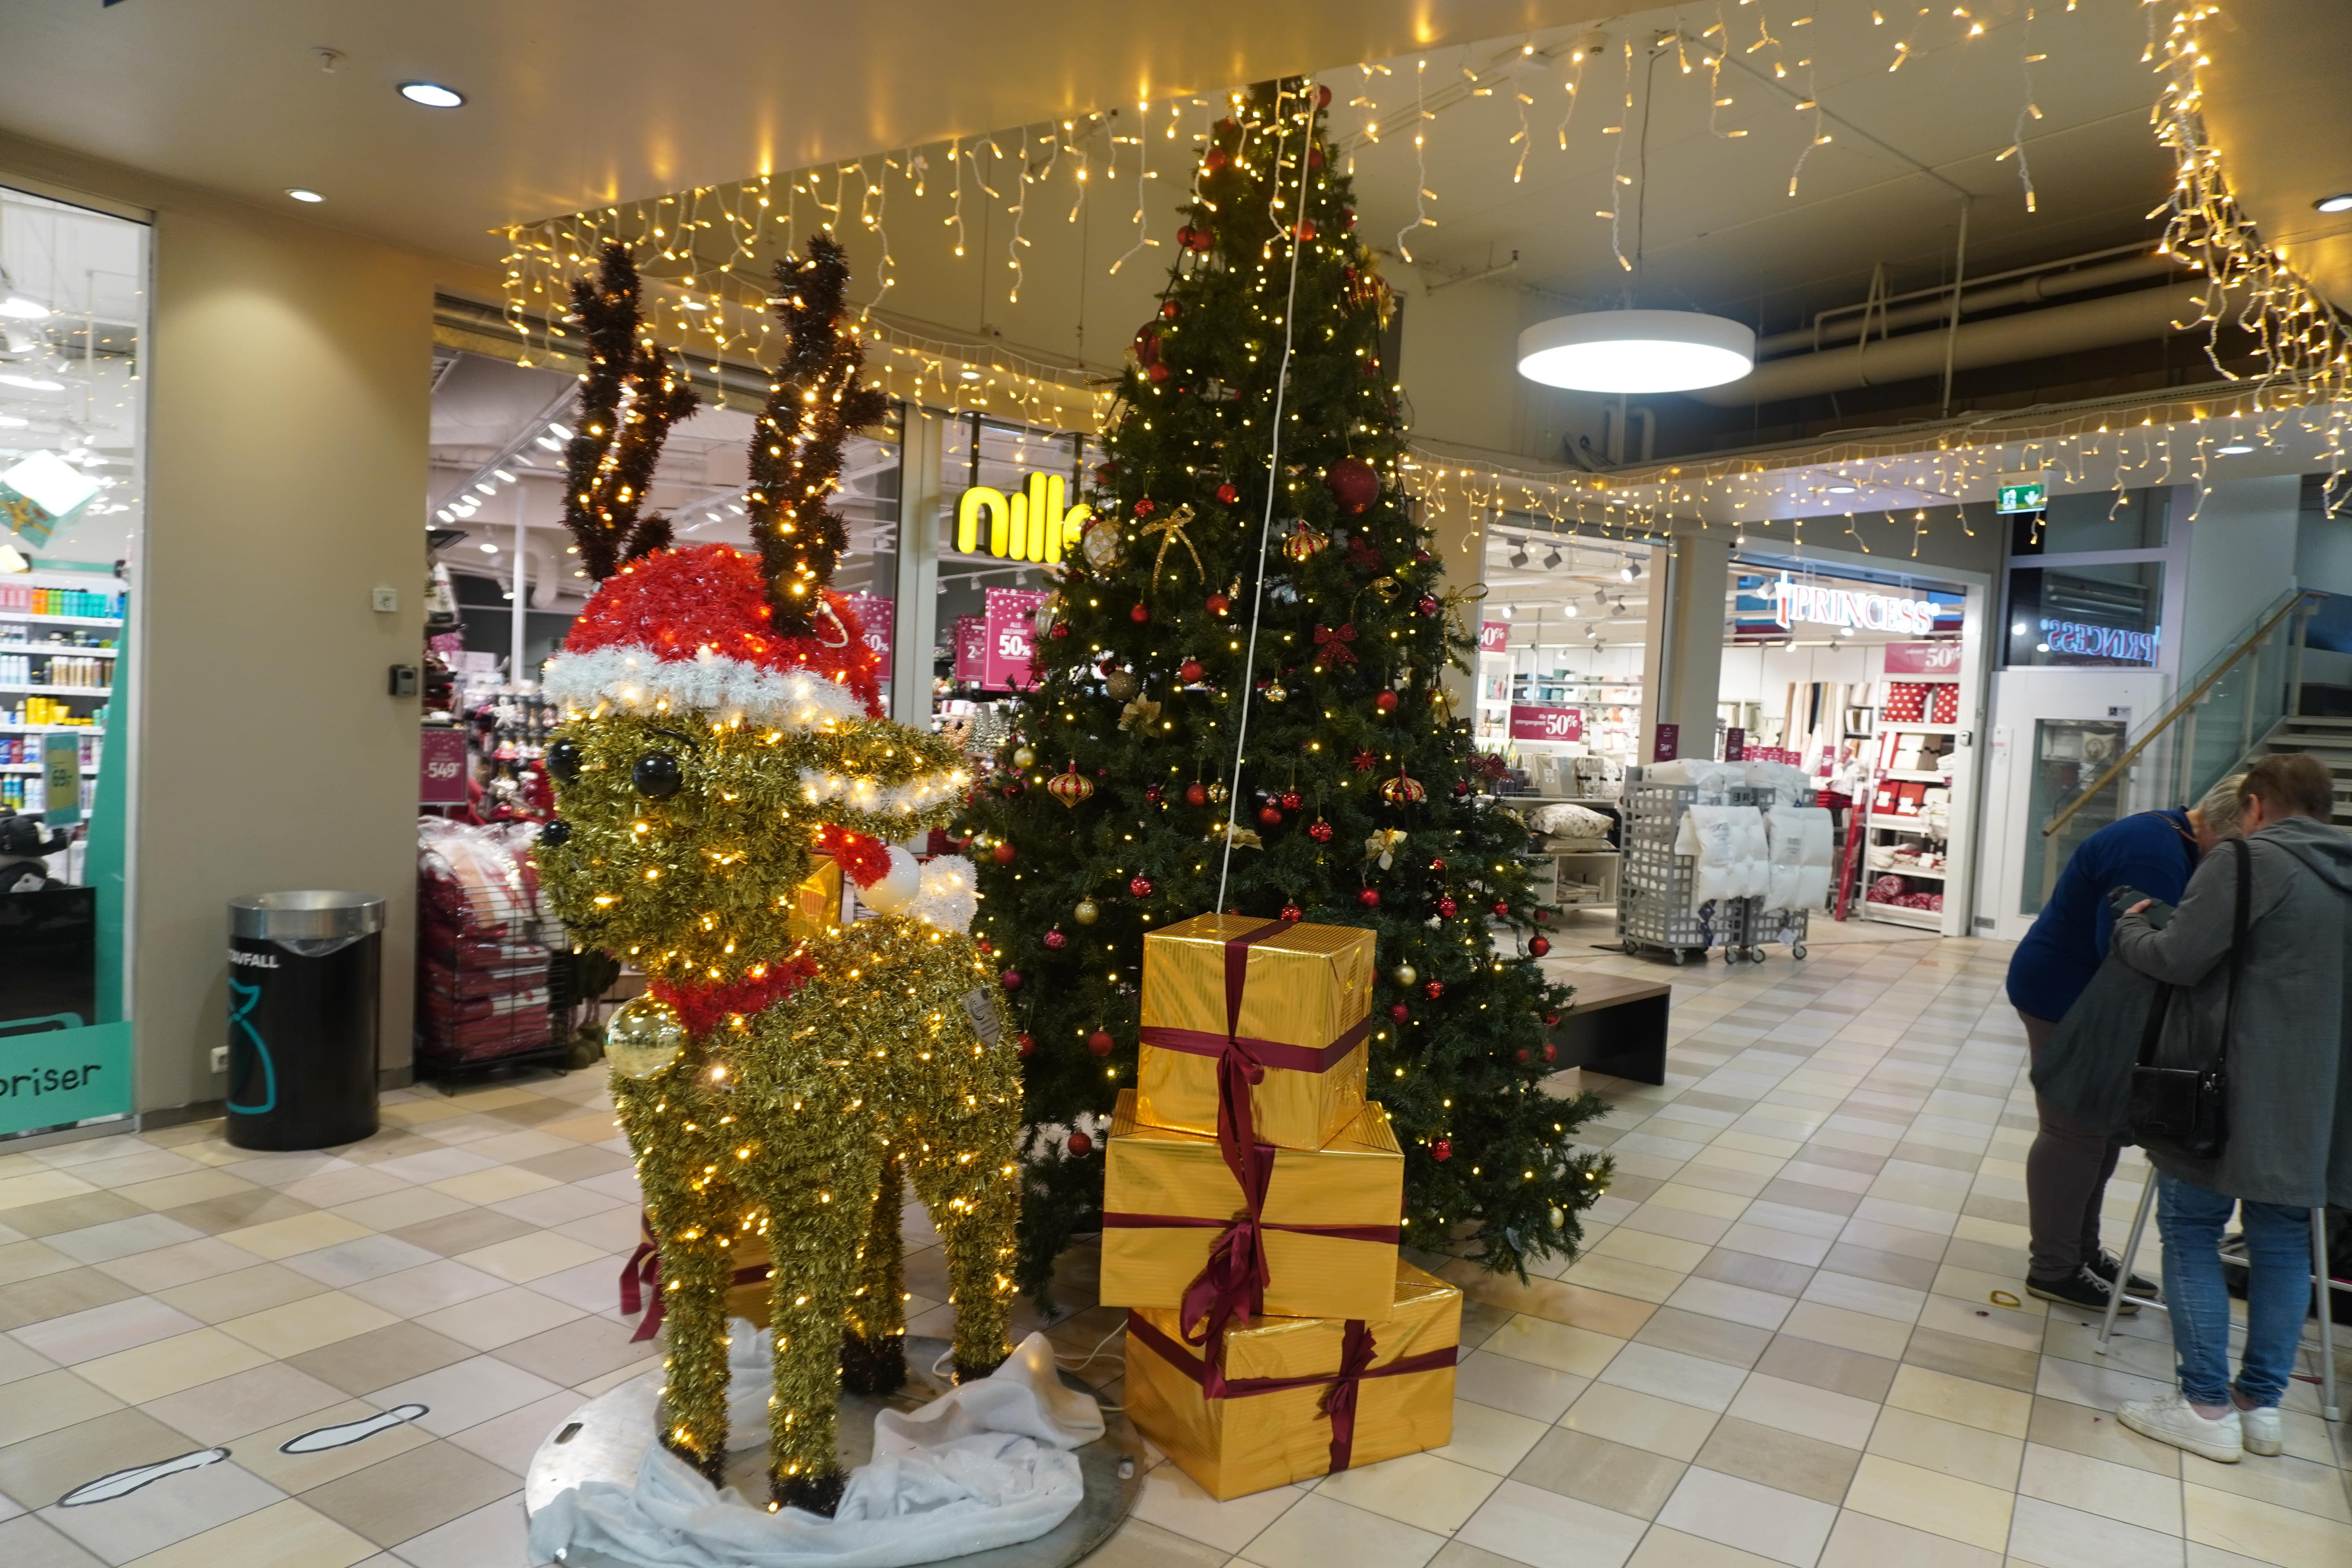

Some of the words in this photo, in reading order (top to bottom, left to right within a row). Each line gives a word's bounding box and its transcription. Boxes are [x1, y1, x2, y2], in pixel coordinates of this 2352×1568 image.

[1790, 584, 1932, 635] PRINCESS
[998, 635, 1031, 656] 50%
[1546, 713, 1578, 735] 50%
